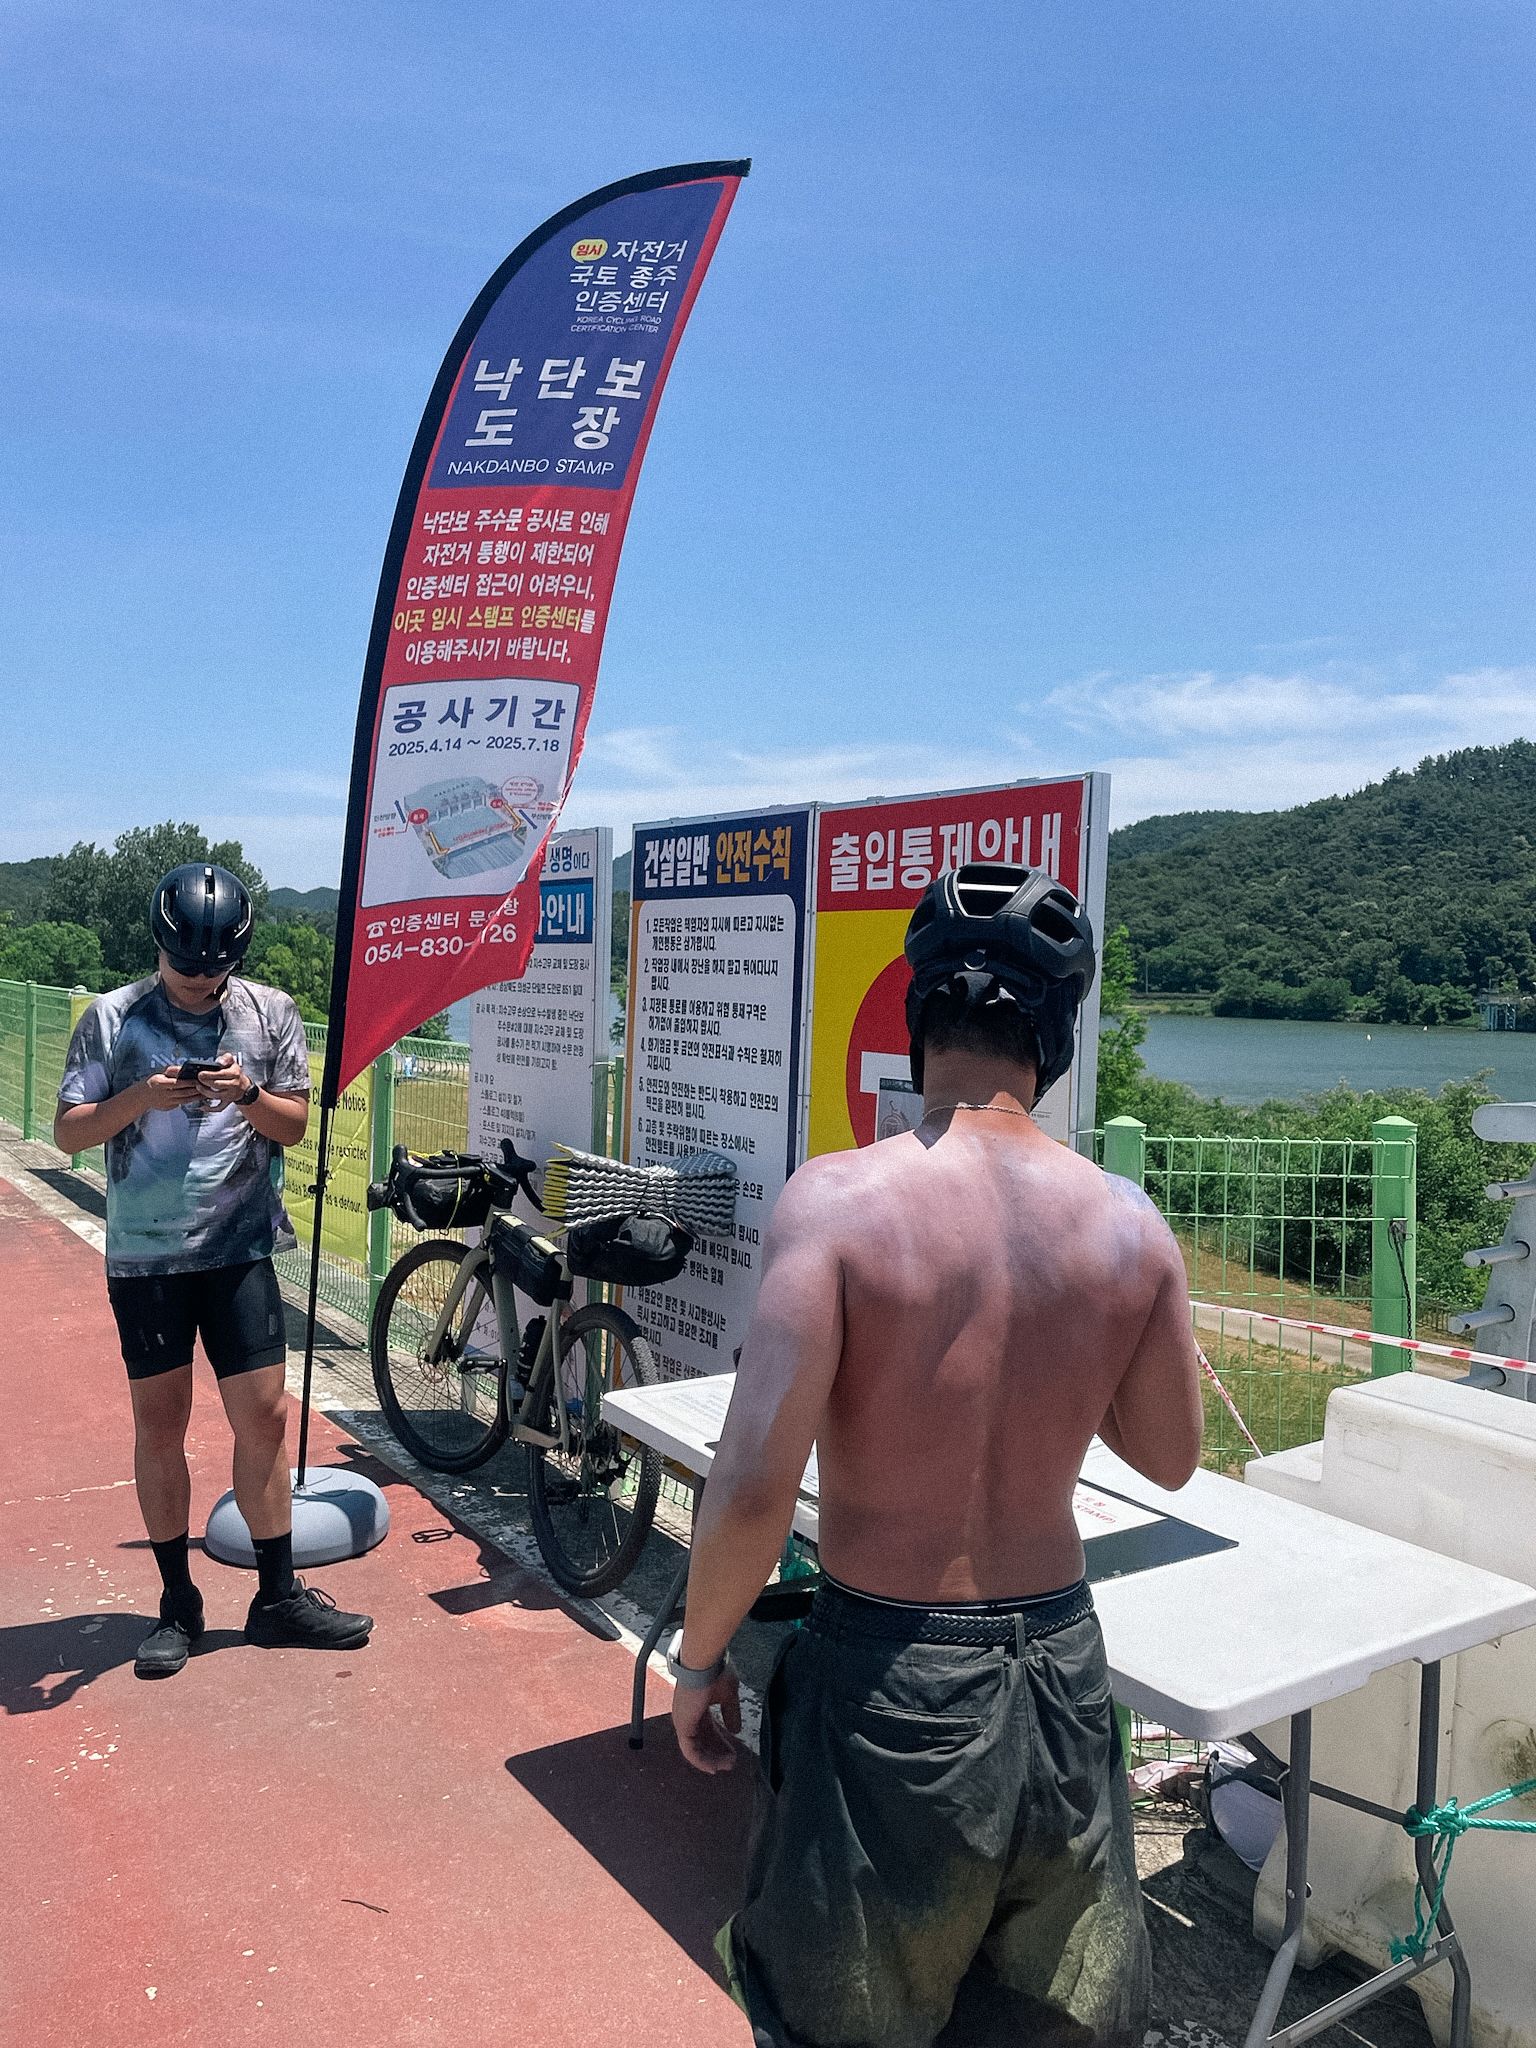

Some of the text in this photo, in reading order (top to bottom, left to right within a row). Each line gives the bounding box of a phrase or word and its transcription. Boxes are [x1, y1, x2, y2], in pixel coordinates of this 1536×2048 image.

[576, 243, 603, 257] 임시
[611, 239, 688, 263] 자전거
[569, 265, 678, 289] 국토 종주
[575, 290, 670, 314] 인증센터
[576, 315, 603, 324] KOREA
[640, 315, 662, 325] ROAD
[628, 324, 659, 334] CENTER
[473, 356, 646, 401] 낙단보
[448, 458, 615, 476] NAKDANBO STAMP
[422, 508, 610, 536] 낙단보 주수문 공사로 인해
[422, 541, 595, 567] 자전거 통행이 제한되어
[406, 573, 595, 601] 인증센터 접근이 어려우니,
[394, 604, 596, 634] 이곳 임시 스탬프 인증센터를
[405, 637, 572, 665] 이용해주시기 바랍니다.
[393, 695, 566, 734] 공사기간
[388, 737, 462, 757] 2025.4.14
[486, 735, 560, 753] 2025.7.18
[550, 845, 590, 873] 생명이다
[644, 825, 792, 889] 건설일반 안전수칙
[390, 909, 460, 936] 인증센터
[691, 958, 711, 974] 장난을
[727, 959, 741, 975] 말고
[698, 1085, 718, 1103] 반드시
[719, 1088, 747, 1107] 착용하고
[742, 1180, 763, 1201] 손으로
